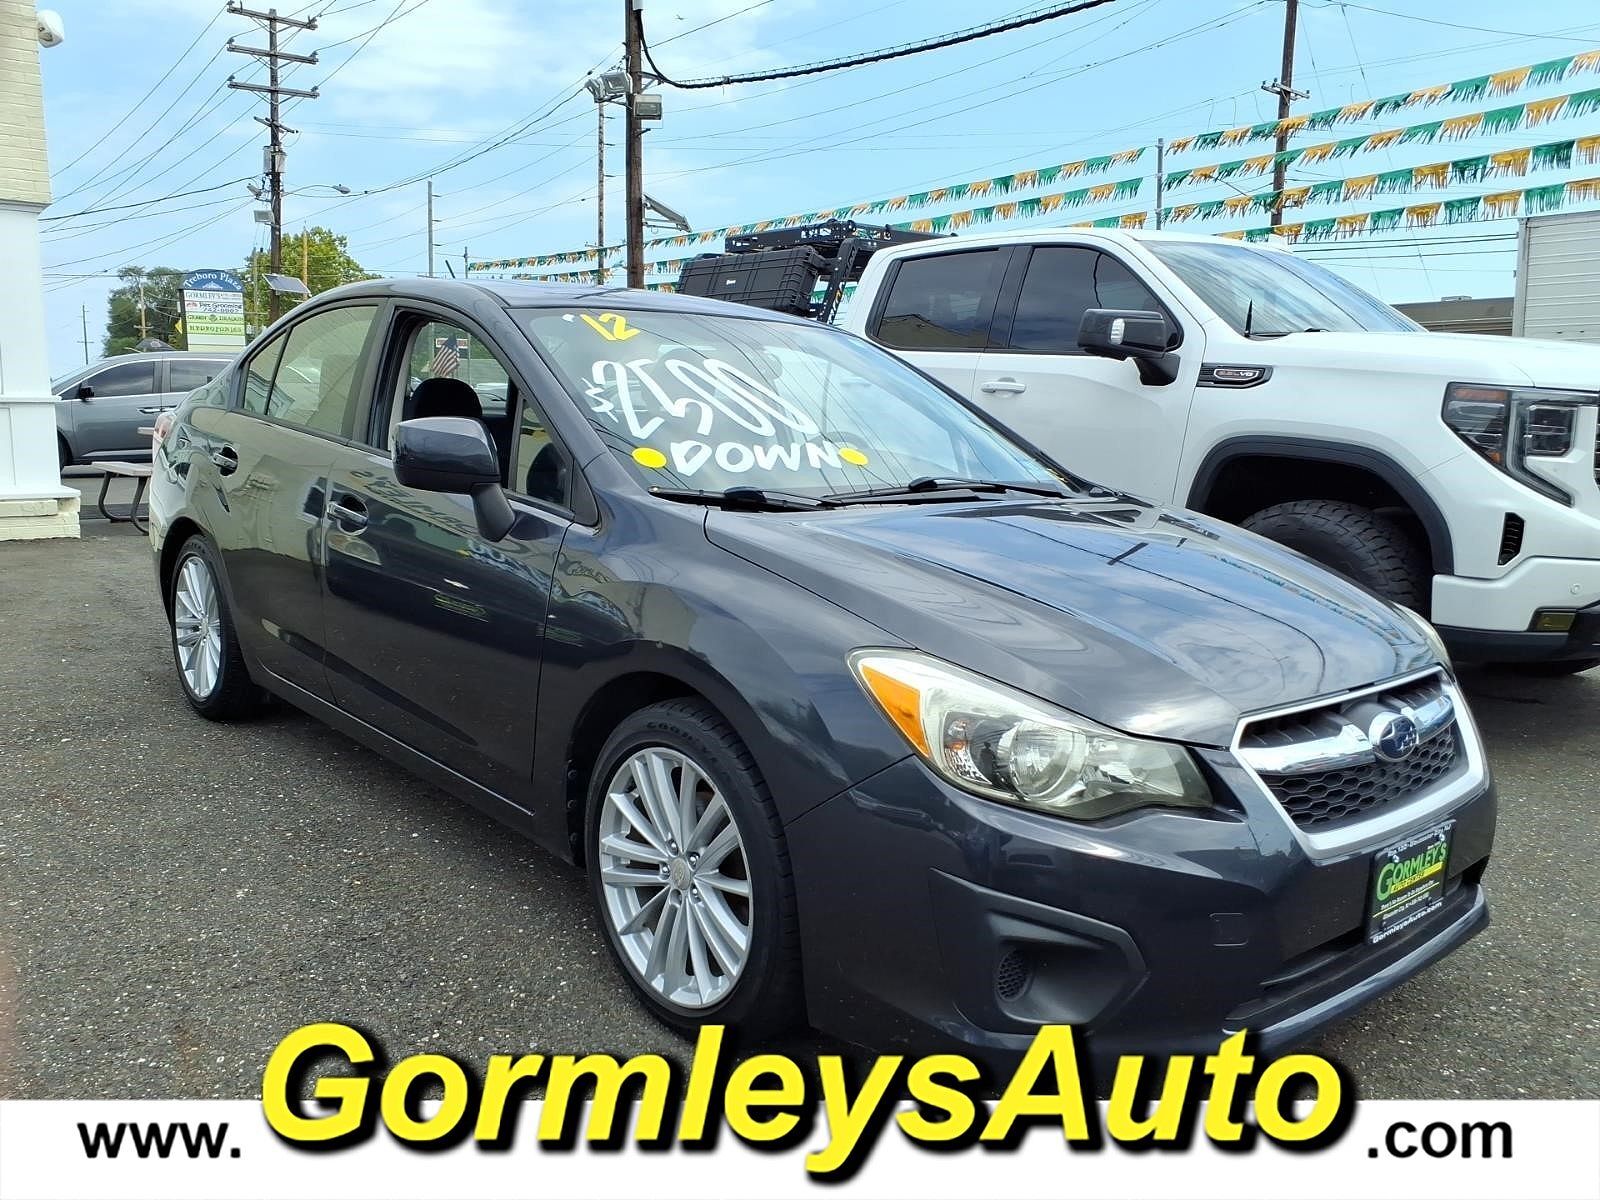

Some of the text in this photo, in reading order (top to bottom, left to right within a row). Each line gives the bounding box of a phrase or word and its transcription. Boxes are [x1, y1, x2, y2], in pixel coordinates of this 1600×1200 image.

[183, 272, 242, 290] Treboro Plaza
[581, 357, 822, 440] $2500
[670, 440, 843, 476] DOWN
[1376, 842, 1448, 901] GORMLEY'S
